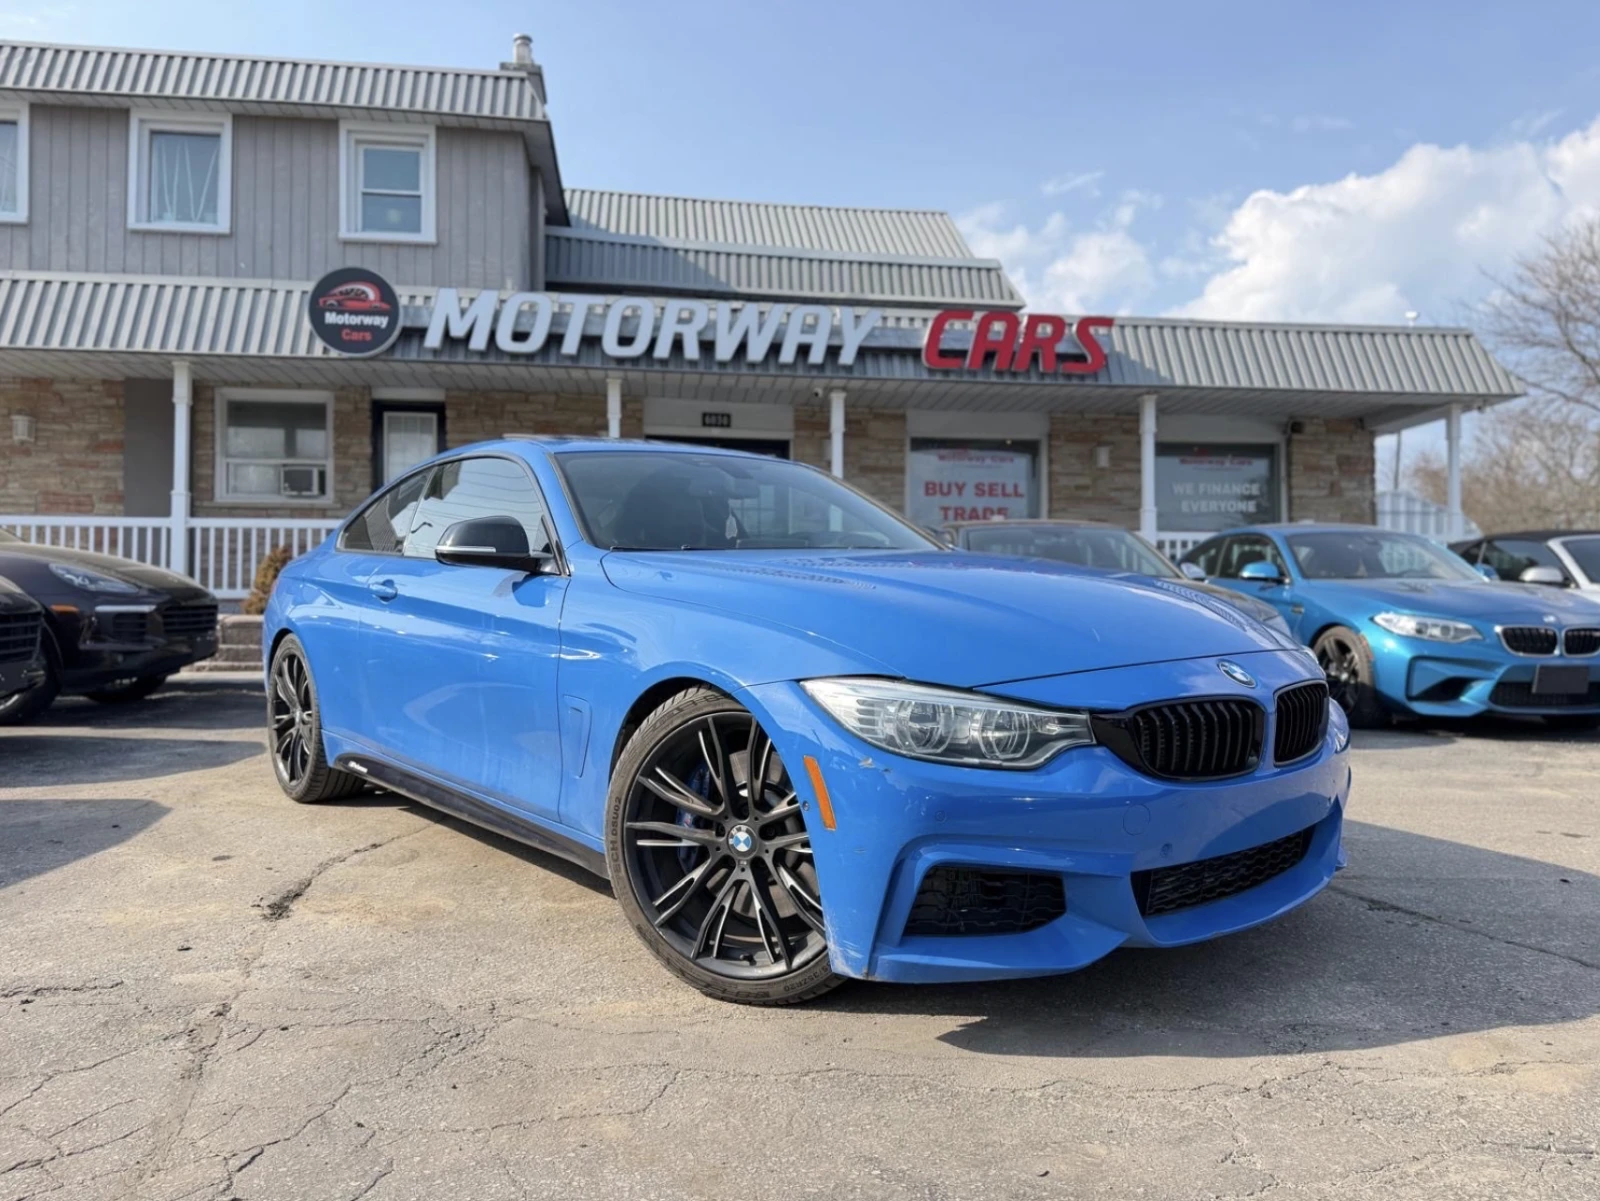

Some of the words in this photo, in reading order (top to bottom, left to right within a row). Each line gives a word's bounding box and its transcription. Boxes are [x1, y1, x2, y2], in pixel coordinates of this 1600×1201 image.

[324, 311, 389, 329] Motorway
[341, 328, 373, 341] Cars
[423, 287, 883, 366] MOTORWAY
[921, 309, 1114, 374] CARS
[924, 481, 967, 497] BUY
[974, 481, 1025, 498] SELL
[1172, 482, 1195, 495] WE
[1199, 482, 1261, 496] FINANCE
[1181, 501, 1257, 513] EVERYONE
